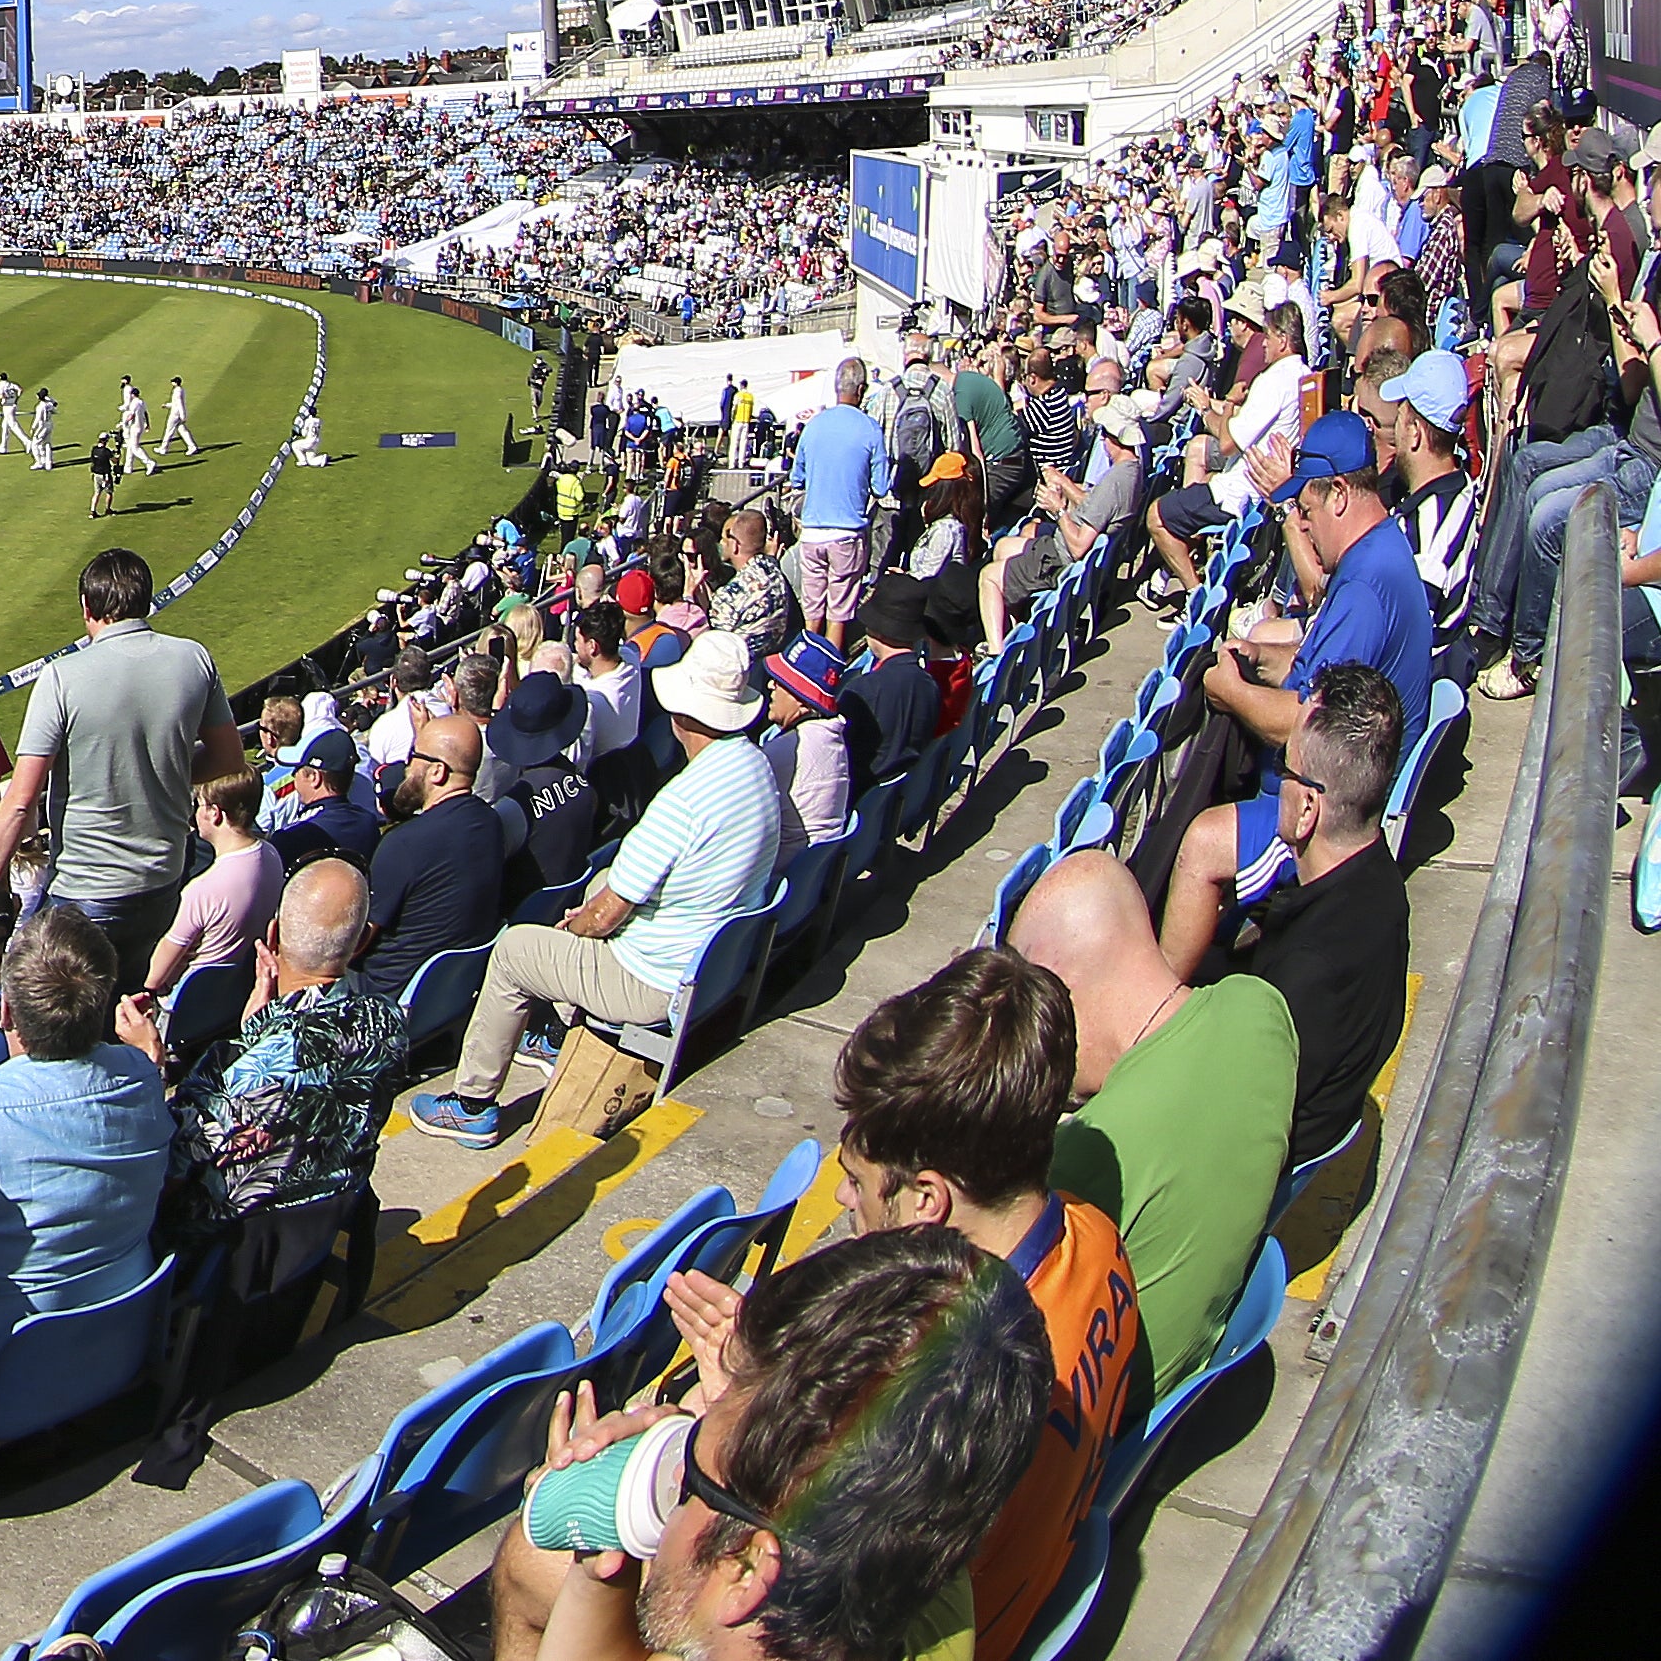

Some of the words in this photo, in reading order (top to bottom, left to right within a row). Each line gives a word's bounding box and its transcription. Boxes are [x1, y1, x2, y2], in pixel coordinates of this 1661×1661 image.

[43, 257, 73, 270] VIRAT
[74, 259, 104, 272] KOHLI
[245, 269, 301, 287] CHETESHWAR
